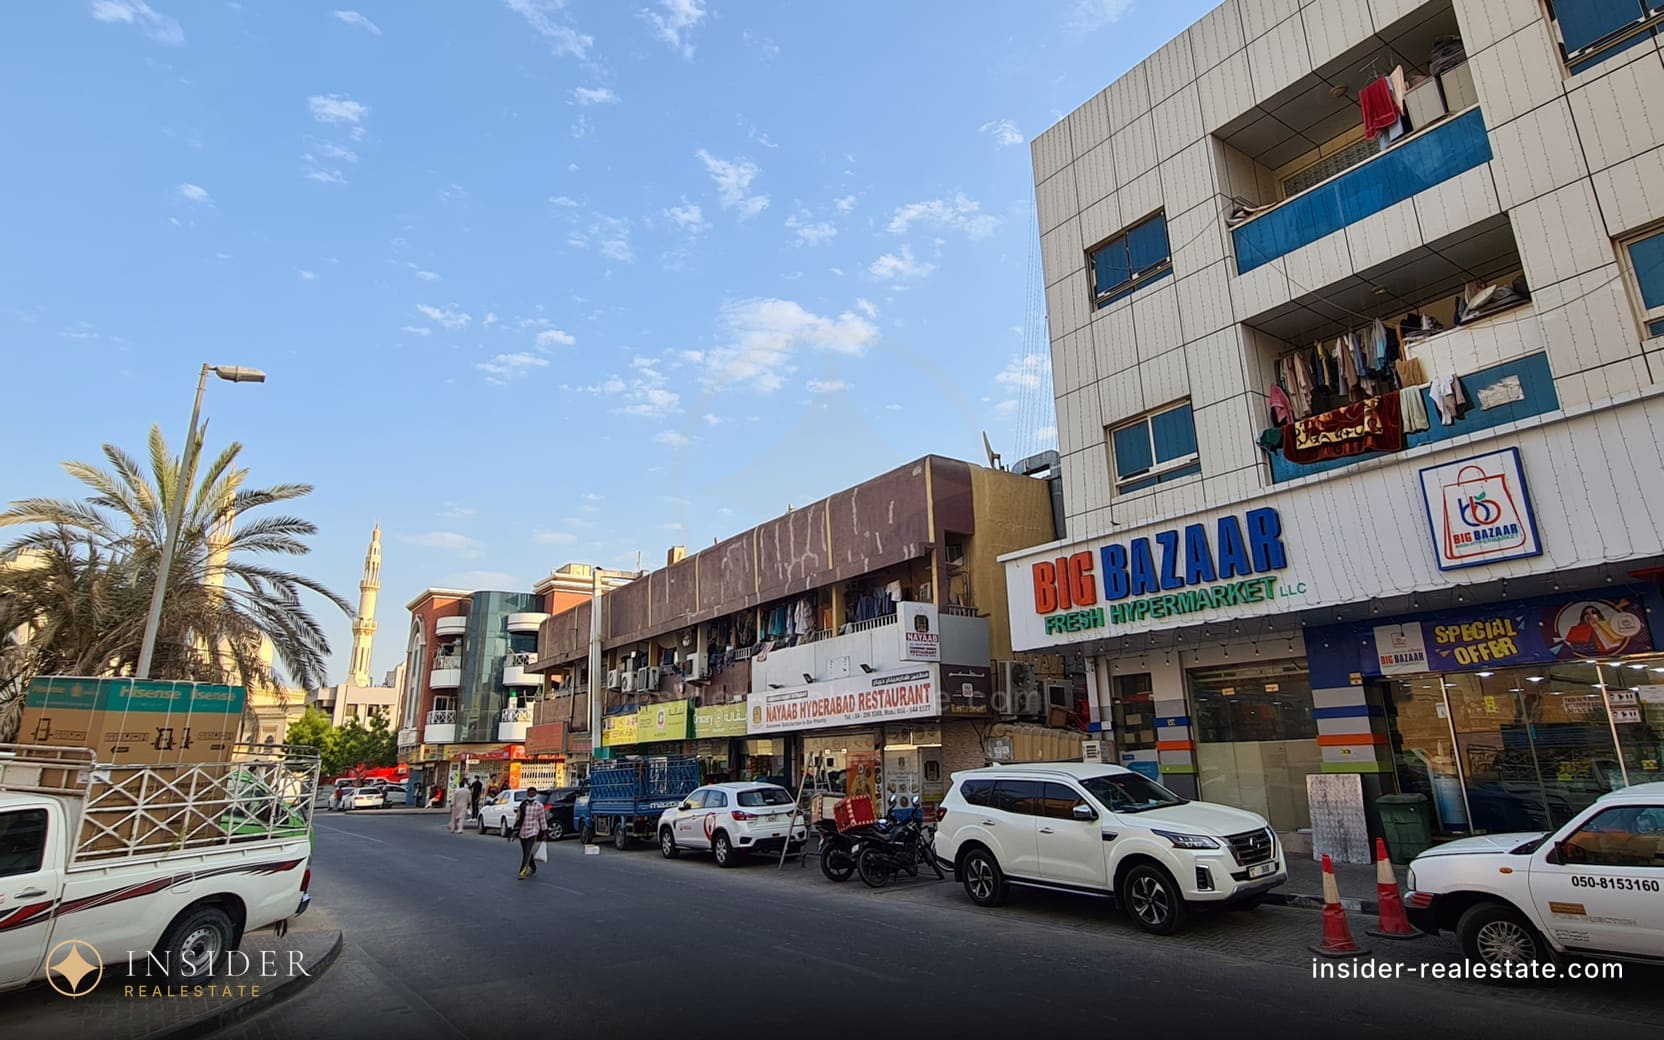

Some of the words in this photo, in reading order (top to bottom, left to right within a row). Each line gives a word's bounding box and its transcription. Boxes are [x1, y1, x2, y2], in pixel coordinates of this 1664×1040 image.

[1453, 532, 1473, 545] BIG
[1473, 523, 1519, 541] BAZAAR
[1032, 551, 1097, 615] BIG
[1101, 507, 1287, 600] BAZAAR
[1044, 607, 1105, 635] FRESH
[1110, 576, 1278, 625] HYPERMARKET
[1279, 582, 1307, 597] LLC
[907, 632, 939, 643] NAYAAB
[1434, 618, 1518, 645] SPECIAL
[1380, 655, 1394, 665] BIG
[1394, 652, 1425, 664] BAZAAR
[1453, 637, 1518, 666] OFFER
[119, 685, 182, 700] Hisense
[766, 703, 798, 723] NAYAAB
[799, 694, 855, 719] HYDERABAD
[858, 682, 931, 712] RESTAURANT
[1571, 875, 1660, 893] 050-8153160
